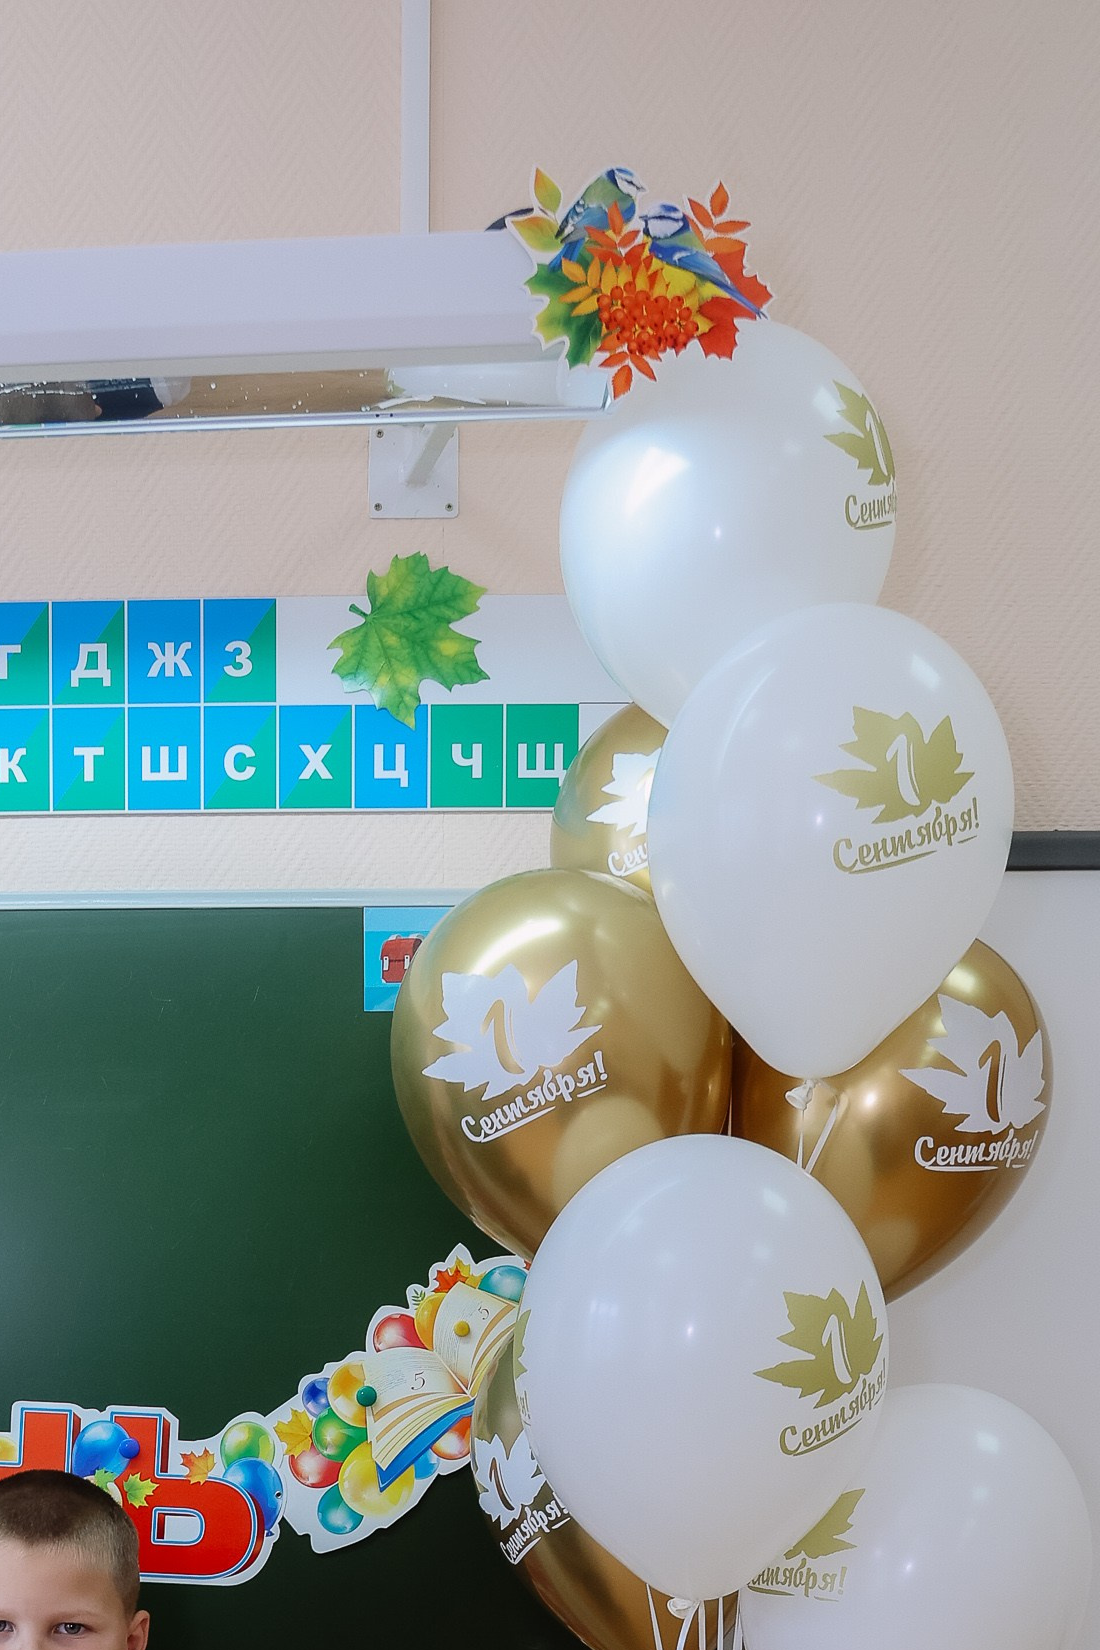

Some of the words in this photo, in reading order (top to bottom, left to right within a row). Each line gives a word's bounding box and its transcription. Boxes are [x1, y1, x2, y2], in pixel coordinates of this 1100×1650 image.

[71, 644, 111, 687] д
[147, 642, 192, 677] ж
[224, 640, 252, 678] з
[0, 748, 27, 783] к
[74, 746, 105, 782] т
[141, 745, 186, 782] ш
[223, 744, 257, 782] с
[298, 744, 332, 779] х
[373, 743, 409, 787] ц
[452, 742, 483, 778] ч
[518, 742, 568, 787] щ
[832, 797, 980, 872] Сентября!
[460, 1050, 608, 1142] Сентября!
[914, 1128, 1039, 1168] Сентября!
[411, 1371, 425, 1390] 5
[779, 1358, 886, 1455] Сентября!
